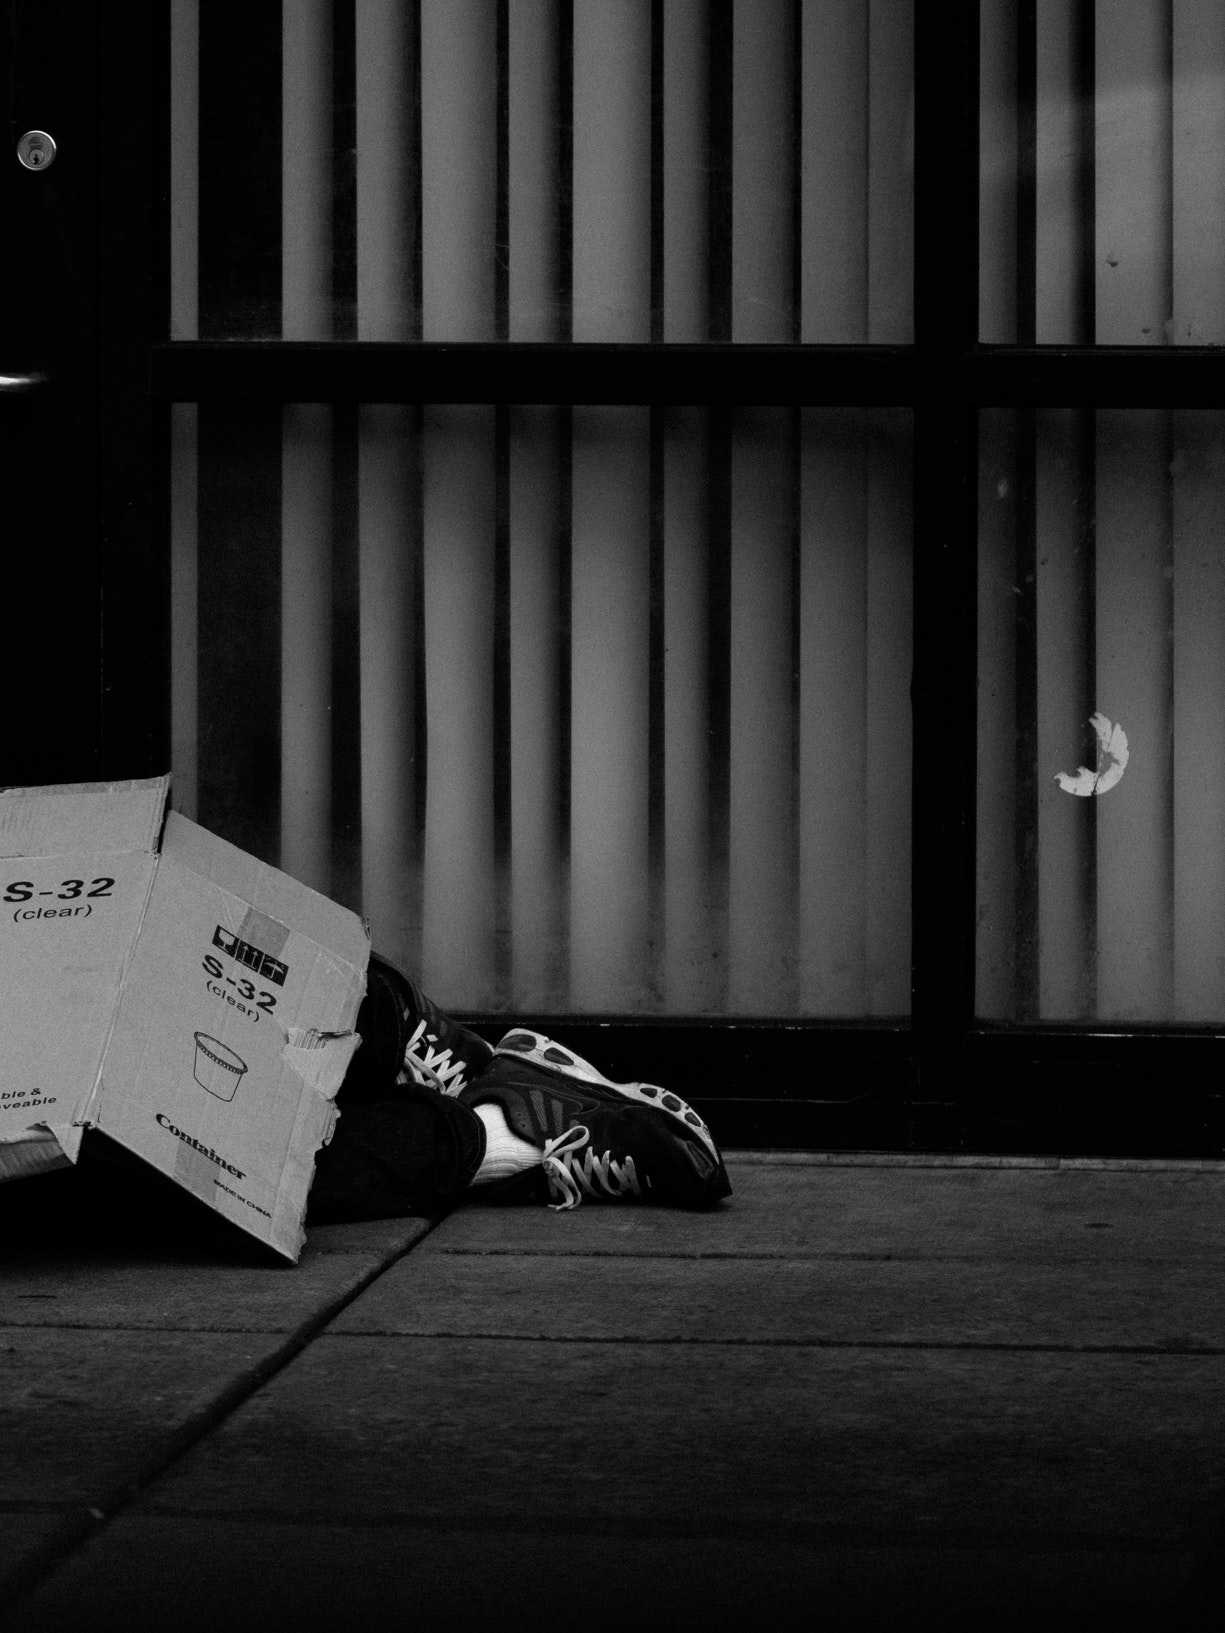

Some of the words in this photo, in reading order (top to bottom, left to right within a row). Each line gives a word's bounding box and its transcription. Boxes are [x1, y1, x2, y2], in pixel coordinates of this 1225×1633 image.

[2, 877, 116, 903] S-32
[12, 904, 93, 923] (clear)
[201, 954, 278, 1016] S-32
[206, 979, 261, 1023] (clear)
[30, 1087, 42, 1097] &
[156, 1113, 248, 1180] Container
